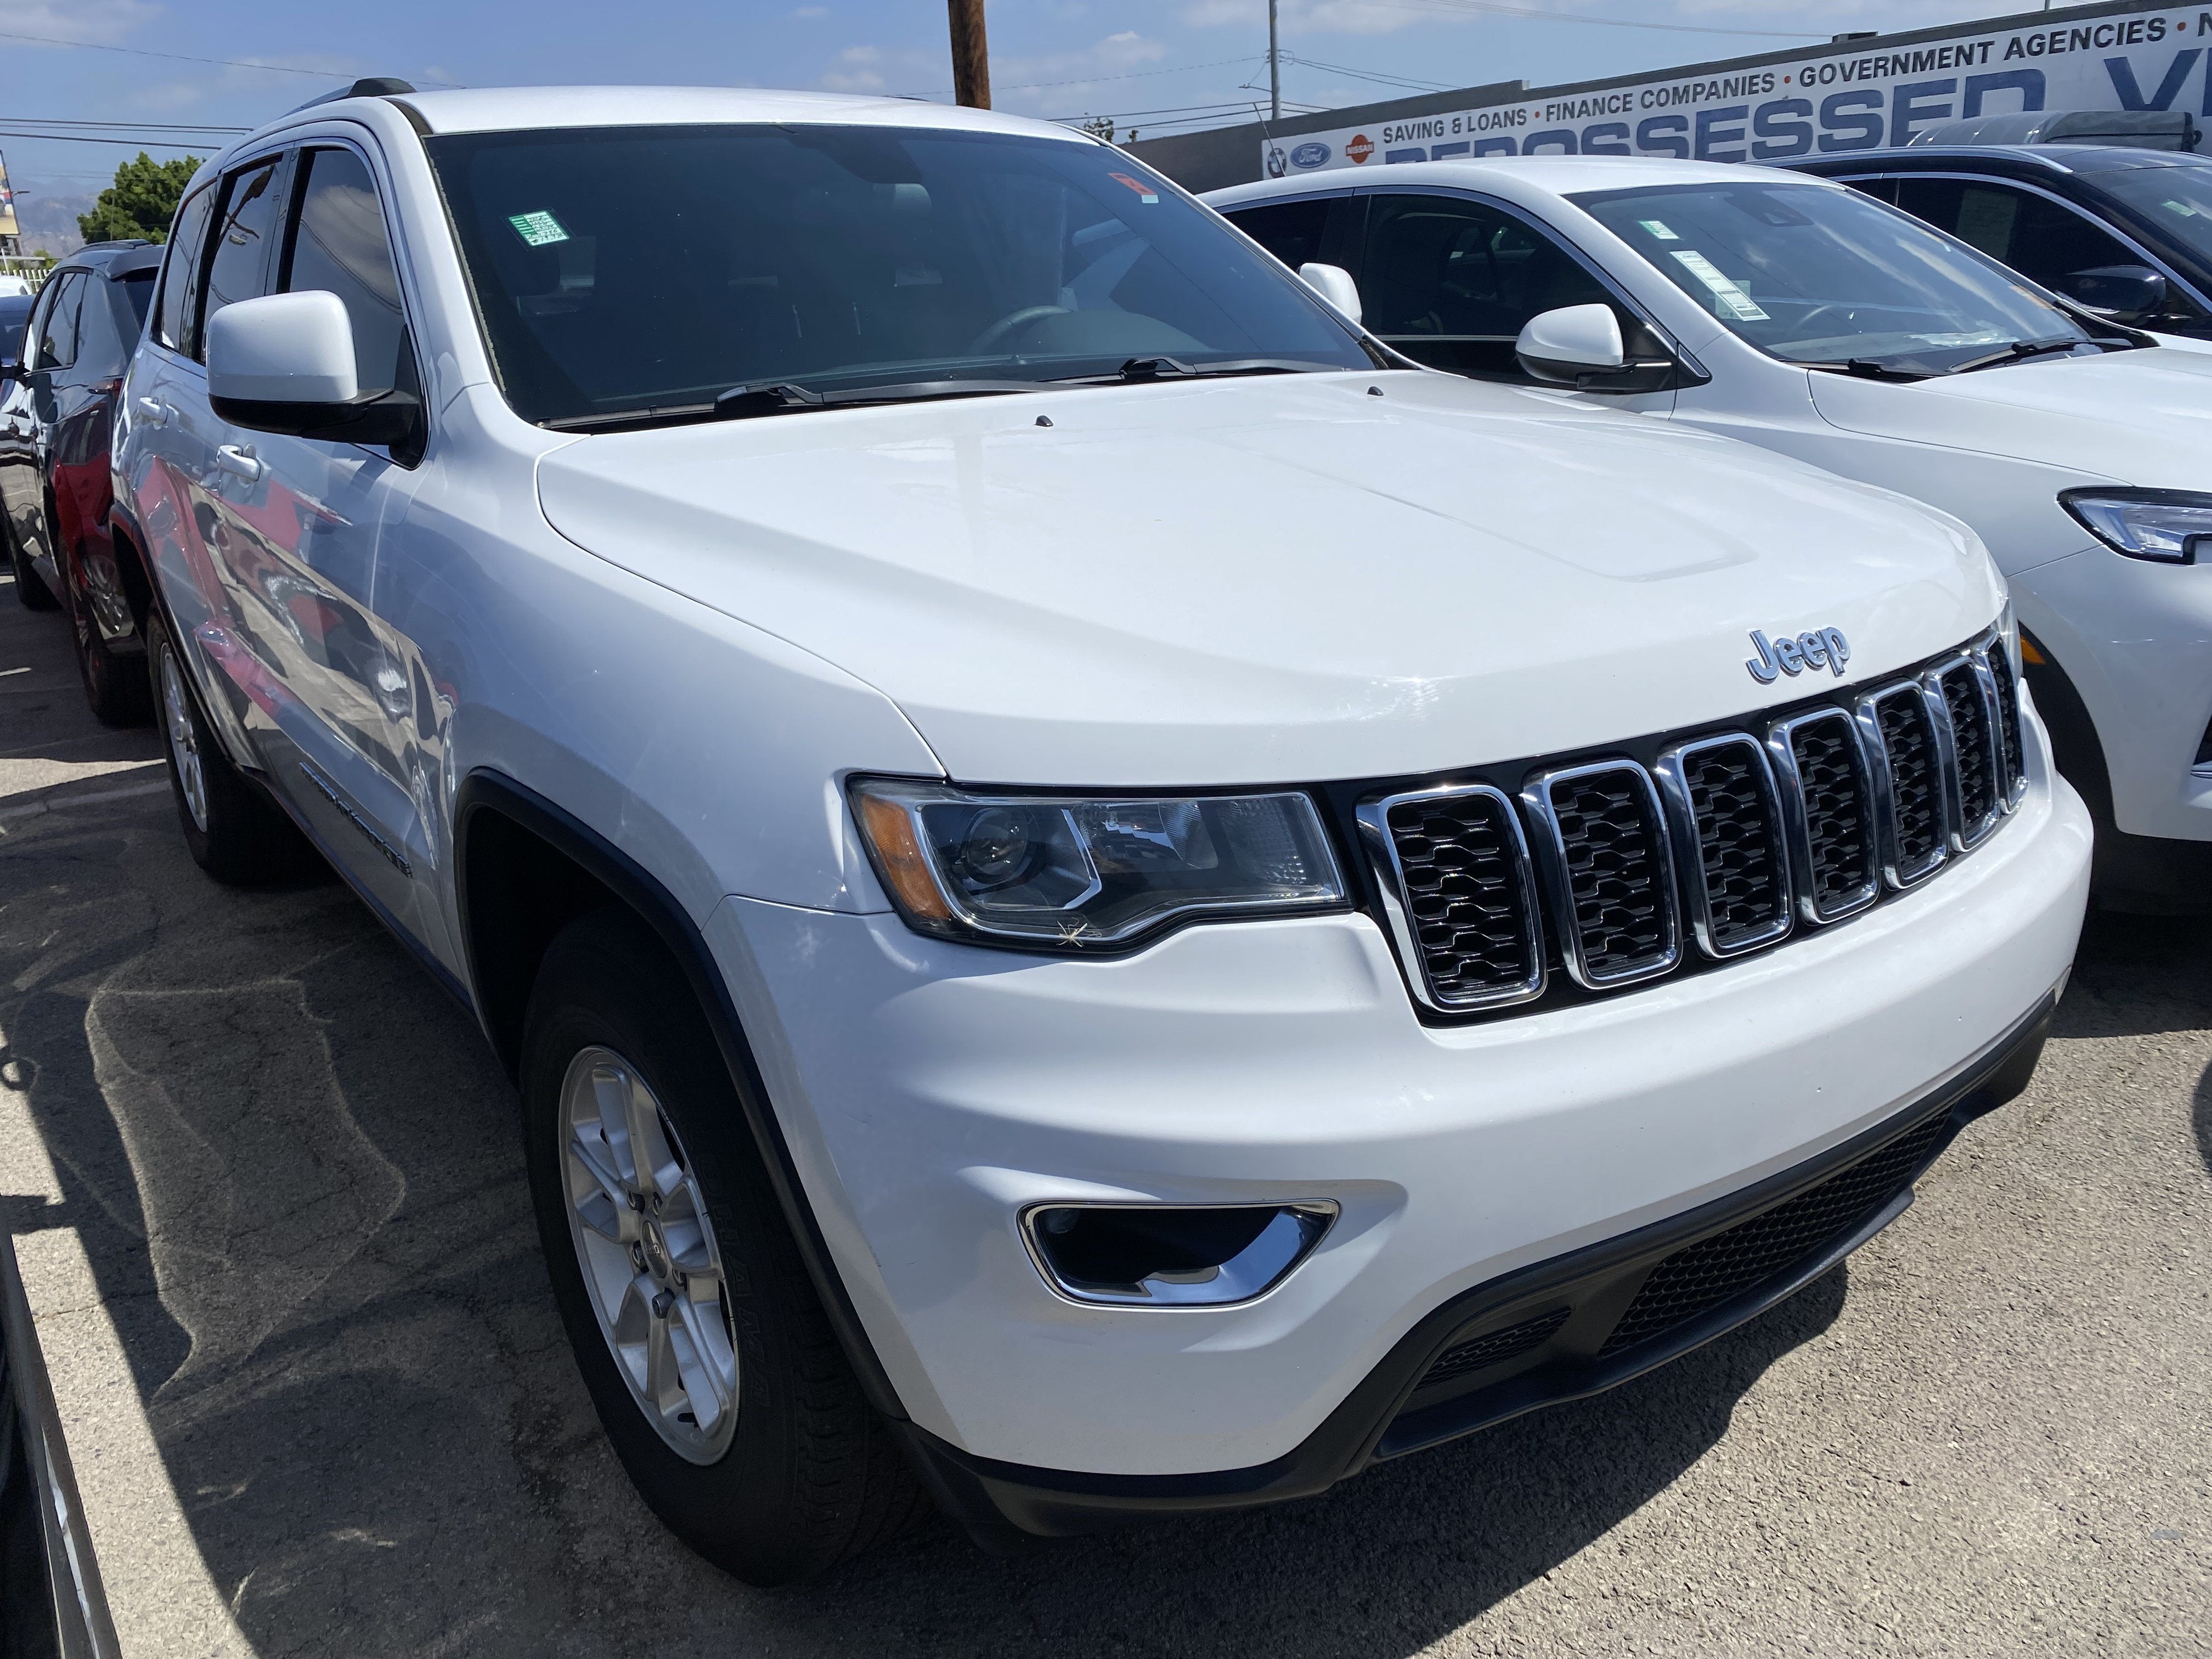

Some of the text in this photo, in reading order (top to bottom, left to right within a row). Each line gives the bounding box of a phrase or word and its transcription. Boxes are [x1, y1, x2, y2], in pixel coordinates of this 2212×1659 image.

[1383, 120, 1444, 144] SAVING
[1452, 117, 1462, 134] &
[1467, 108, 1527, 133] LOANS
[1546, 93, 1634, 122] FINANCE
[1640, 72, 1775, 109] COMPANIES
[1799, 40, 1995, 87] GOVERNMENT
[2003, 17, 2167, 61] AGENCIES
[2103, 48, 2212, 117] V
[1298, 148, 1323, 163] Ford
[1745, 627, 1851, 685] Jeep
